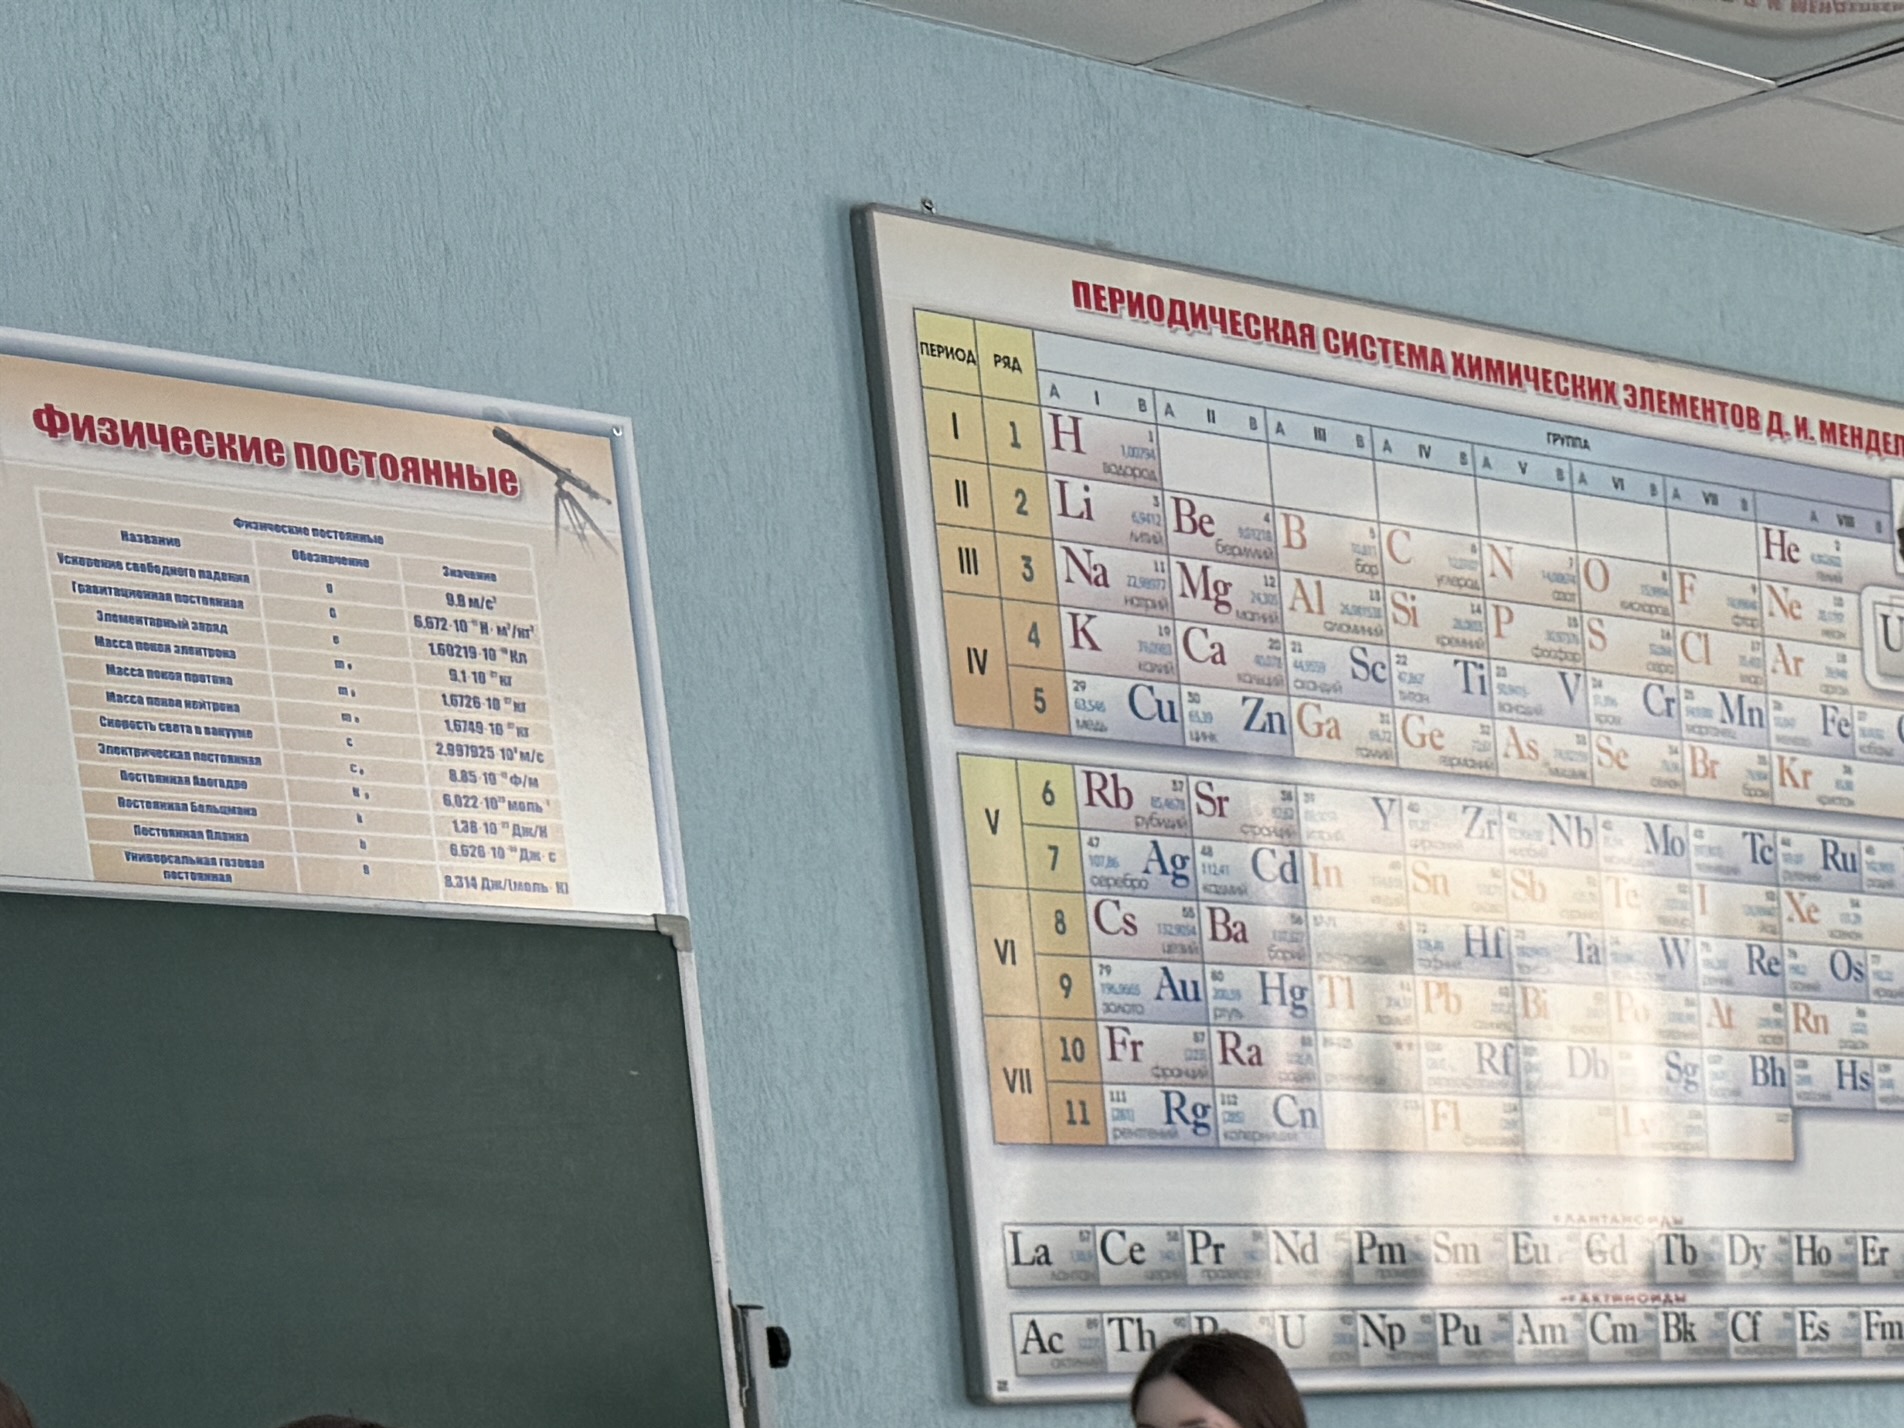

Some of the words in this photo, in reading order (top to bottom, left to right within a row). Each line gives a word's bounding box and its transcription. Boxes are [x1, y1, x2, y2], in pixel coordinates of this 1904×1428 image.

[920, 341, 977, 365] ПЕРИОД
[994, 354, 1023, 373] РЯД
[1072, 280, 1317, 350] ПЕРИОДИЧЕСКАЯ
[1323, 328, 1446, 376] СИСТЕМА
[1451, 350, 1617, 407] ХИМИЧЕСКИХ
[1624, 384, 1761, 434] ЭЛЕМЕНТОВ
[1766, 410, 1791, 440] Д.
[1794, 415, 1815, 441] И.
[952, 412, 959, 439] I
[1009, 421, 1021, 449] 1
[1048, 412, 1086, 454] H
[1547, 431, 1591, 451] ГРУППА
[33, 403, 286, 467] Физические
[294, 441, 519, 497] постоянные
[955, 479, 968, 508] II
[1015, 488, 1028, 516] 2
[1055, 479, 1095, 521] Li
[1170, 496, 1216, 538] Be
[1279, 512, 1308, 550] B
[958, 546, 978, 576] III
[1386, 528, 1412, 565] C
[1487, 543, 1514, 581] N
[1762, 527, 1801, 563] He
[1021, 555, 1035, 582] 3
[1060, 545, 1110, 588] Na
[1583, 557, 1610, 593] O
[1176, 561, 1233, 615] Mg
[1289, 578, 1326, 616] Al
[1677, 571, 1697, 605] F
[1766, 584, 1803, 622] Ne
[1391, 591, 1419, 628] Si
[1491, 604, 1514, 640] P
[1028, 622, 1040, 648] 4
[1068, 612, 1102, 652] K
[1182, 626, 1227, 666] Ca
[1587, 618, 1608, 651] S
[1680, 630, 1712, 666] Cl
[1880, 613, 1904, 652] U
[967, 647, 988, 675] IV
[1350, 645, 1387, 683] Sc
[1454, 658, 1487, 696] Ti
[1769, 642, 1805, 678] Ar
[1034, 687, 1046, 713] 5
[1128, 683, 1178, 723] Cu
[1558, 671, 1582, 706] V
[1643, 682, 1677, 719] Cr
[1241, 696, 1287, 735] Zn
[1296, 701, 1342, 741] Ga
[1718, 691, 1765, 729] Mn
[1820, 703, 1851, 738] Fe
[1401, 713, 1445, 750] Ge
[1503, 725, 1540, 761] As
[1595, 734, 1629, 771] Se
[1688, 745, 1720, 781] Br
[1081, 769, 1134, 810] Rb
[1777, 755, 1814, 790] Kr
[1042, 780, 1055, 806] 6
[1194, 780, 1230, 818] Sr
[985, 808, 1000, 835] V
[1462, 804, 1498, 841] Zr
[1547, 812, 1593, 849] Nb
[1643, 821, 1686, 858] Mo
[1048, 845, 1059, 871] 7
[1142, 840, 1190, 888] Ag
[1251, 847, 1299, 885] Cd
[1742, 831, 1773, 866] Tc
[1820, 838, 1858, 874] Ru
[1055, 909, 1066, 935] 8
[1094, 899, 1138, 937] Cs
[1206, 906, 1249, 944] Ba
[1784, 891, 1821, 925] Xe
[994, 938, 1017, 966] VI
[1463, 924, 1506, 960] Hf
[1745, 943, 1781, 977] Re
[1155, 966, 1202, 1002] Au
[1829, 949, 1865, 983] Os
[1059, 973, 1072, 999] 9
[1258, 970, 1309, 1018] Hg
[1791, 1001, 1830, 1036] Rn
[1060, 1036, 1085, 1063] 10
[1105, 1025, 1144, 1062] Fr
[1217, 1030, 1263, 1066] Ra
[1003, 1067, 1033, 1094] VII
[1748, 1054, 1786, 1088] Bh
[1836, 1059, 1872, 1092] Hs
[1066, 1100, 1090, 1125] 11
[1160, 1089, 1212, 1137] Rg
[1273, 1094, 1318, 1130] Cn
[1009, 1230, 1053, 1267] La
[1100, 1229, 1146, 1266] Ce
[1187, 1229, 1226, 1266] Pr
[1354, 1229, 1407, 1266] Pm
[1658, 1233, 1697, 1267] Tb
[1795, 1234, 1832, 1268] Ho
[1861, 1235, 1889, 1267] Er
[1020, 1319, 1065, 1355] Ac
[1360, 1314, 1407, 1352] Np
[1439, 1312, 1482, 1347] Pu
[1517, 1312, 1567, 1346] Am
[1589, 1311, 1638, 1346] Cm
[1662, 1311, 1697, 1344] Bk
[1730, 1310, 1762, 1344] Cf
[1798, 1311, 1830, 1342] Es
[1864, 1310, 1904, 1340] Fm
